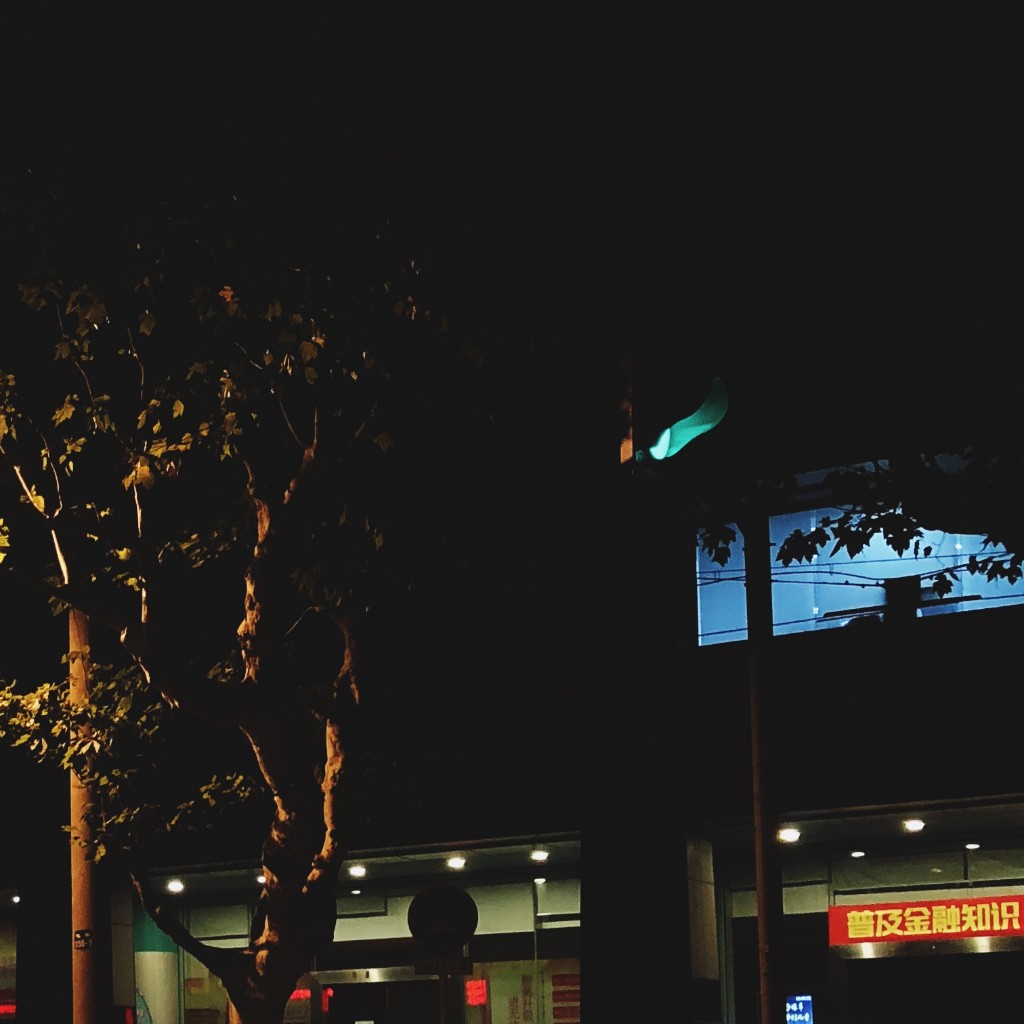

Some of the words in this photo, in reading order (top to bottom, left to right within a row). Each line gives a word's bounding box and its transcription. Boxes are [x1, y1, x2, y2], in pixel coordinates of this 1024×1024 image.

[846, 901, 1021, 939] 普及金融知识
